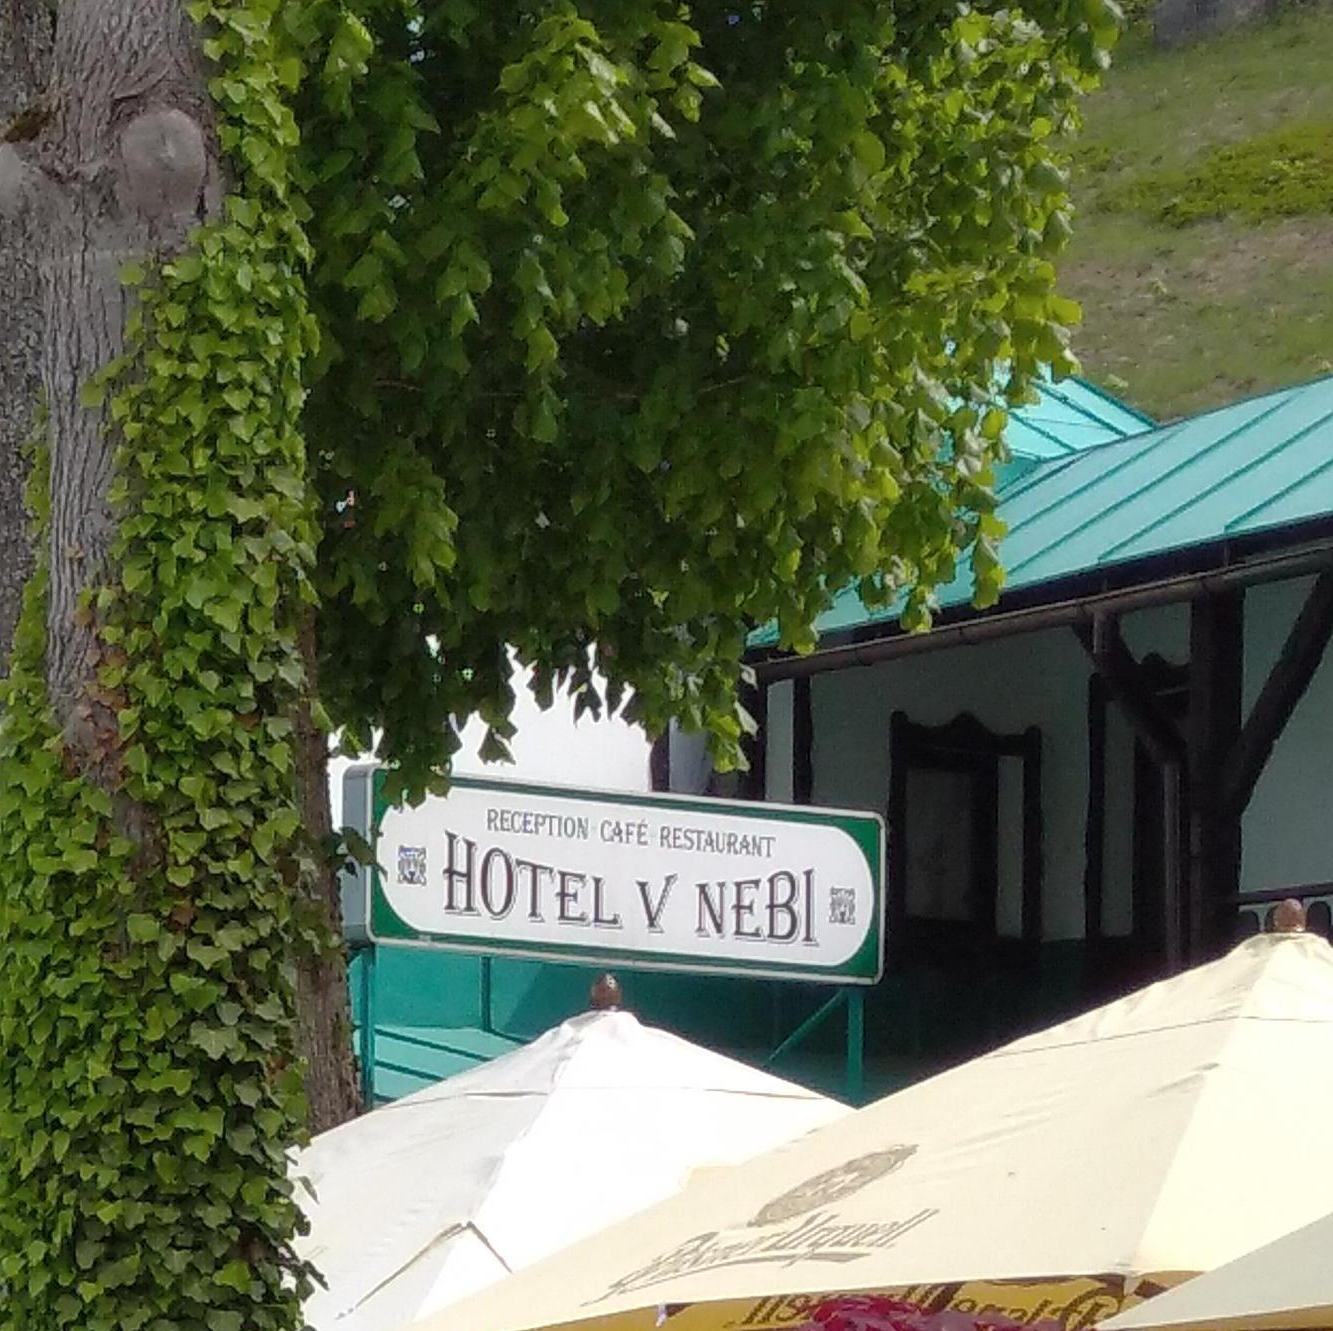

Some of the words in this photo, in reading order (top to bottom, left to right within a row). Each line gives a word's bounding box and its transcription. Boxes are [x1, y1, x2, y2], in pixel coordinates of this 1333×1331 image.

[485, 808, 589, 841] RECEPTION
[599, 819, 649, 847] CAFÉ
[659, 825, 777, 858] RESTAURANT
[442, 830, 624, 930] HOTEL
[635, 872, 678, 934] V
[694, 866, 820, 947] NEBI
